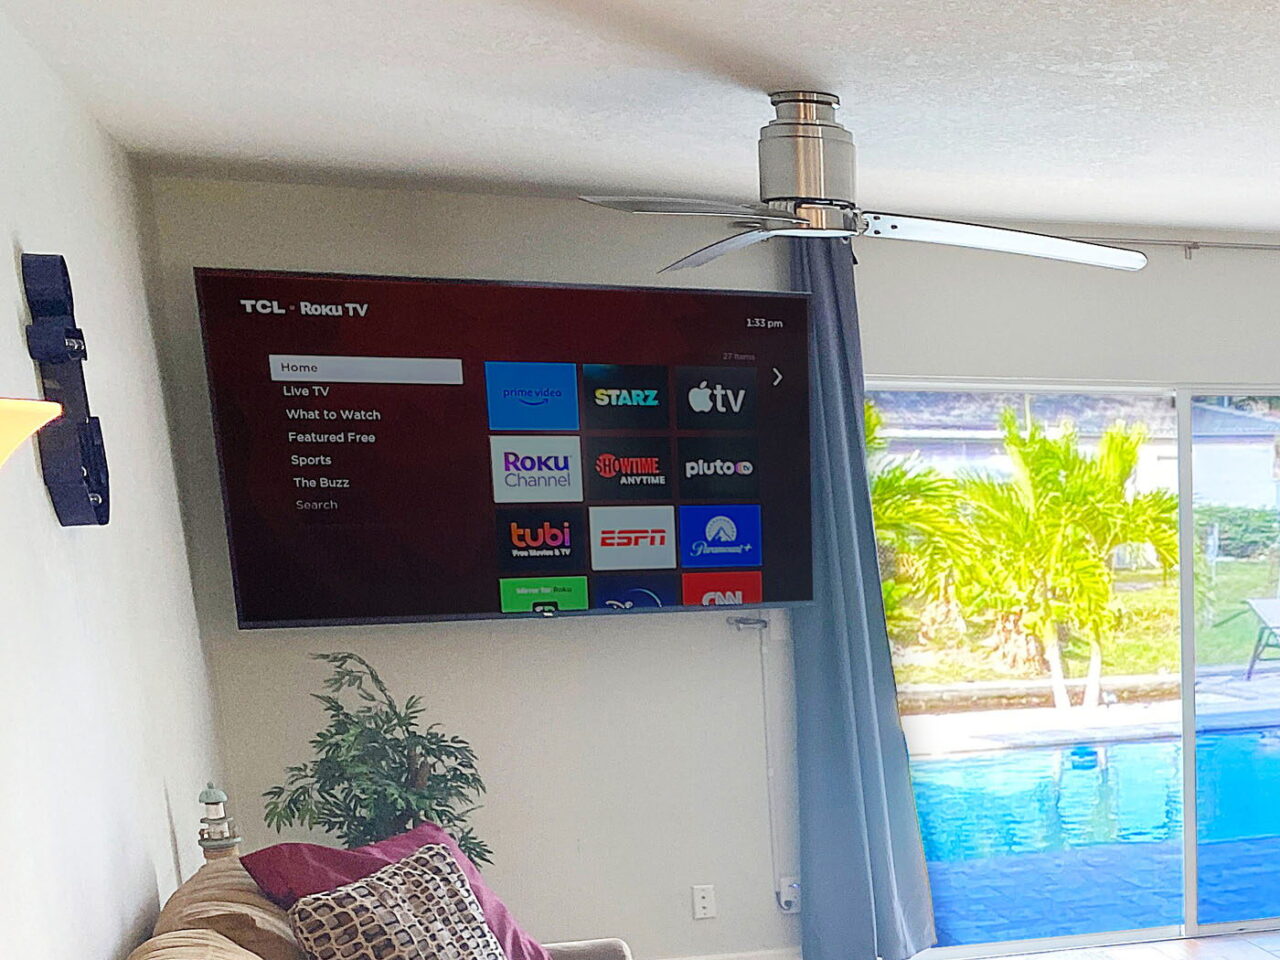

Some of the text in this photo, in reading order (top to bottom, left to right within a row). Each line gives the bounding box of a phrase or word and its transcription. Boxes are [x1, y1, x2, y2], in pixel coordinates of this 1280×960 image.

[240, 299, 368, 317] TCL Roku TV
[746, 318, 783, 328] 1:33 pm
[281, 362, 318, 373] Home
[283, 385, 330, 397] Live TV
[503, 388, 562, 399] prime video
[595, 389, 659, 406] STARZ
[715, 384, 746, 413] tv
[286, 409, 381, 420] What to Watch
[288, 432, 376, 443] Featured Free
[291, 455, 332, 467] Sports
[504, 452, 570, 472] Roku
[595, 453, 660, 478] SHOWTIME
[685, 459, 735, 478] pluto
[293, 478, 350, 488] The Buzz
[505, 473, 570, 487] Channel
[620, 476, 666, 485] ANYTIME
[296, 501, 338, 510] Search
[511, 522, 570, 548] tubi
[600, 529, 666, 547] ESPN
